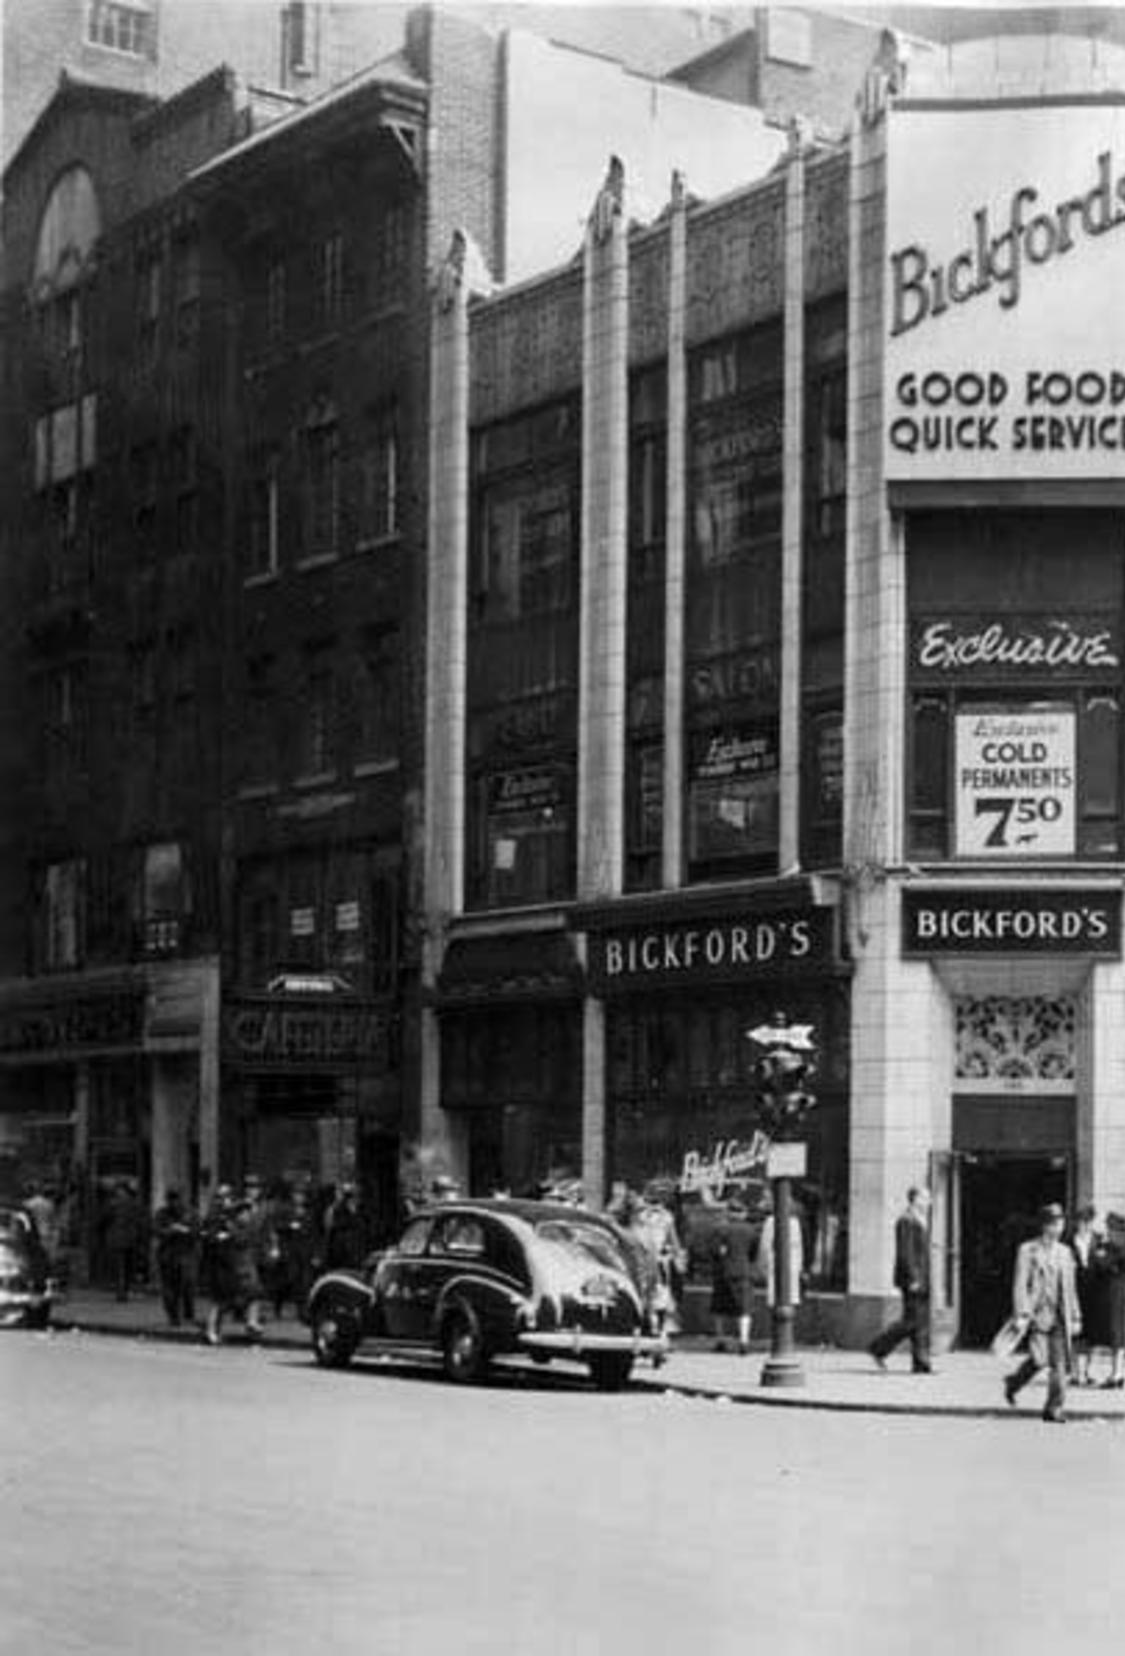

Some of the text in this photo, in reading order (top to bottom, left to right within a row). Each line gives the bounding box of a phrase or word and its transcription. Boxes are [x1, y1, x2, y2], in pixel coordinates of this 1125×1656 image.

[896, 370, 1008, 407] GOOD
[889, 415, 999, 454] QUICK
[919, 621, 1119, 668] Exclusive
[981, 742, 1048, 763] COLD
[961, 767, 1072, 789] PERMANENTS
[917, 908, 1108, 938] BICKFORD'S
[606, 921, 810, 975] BICKFORD'S
